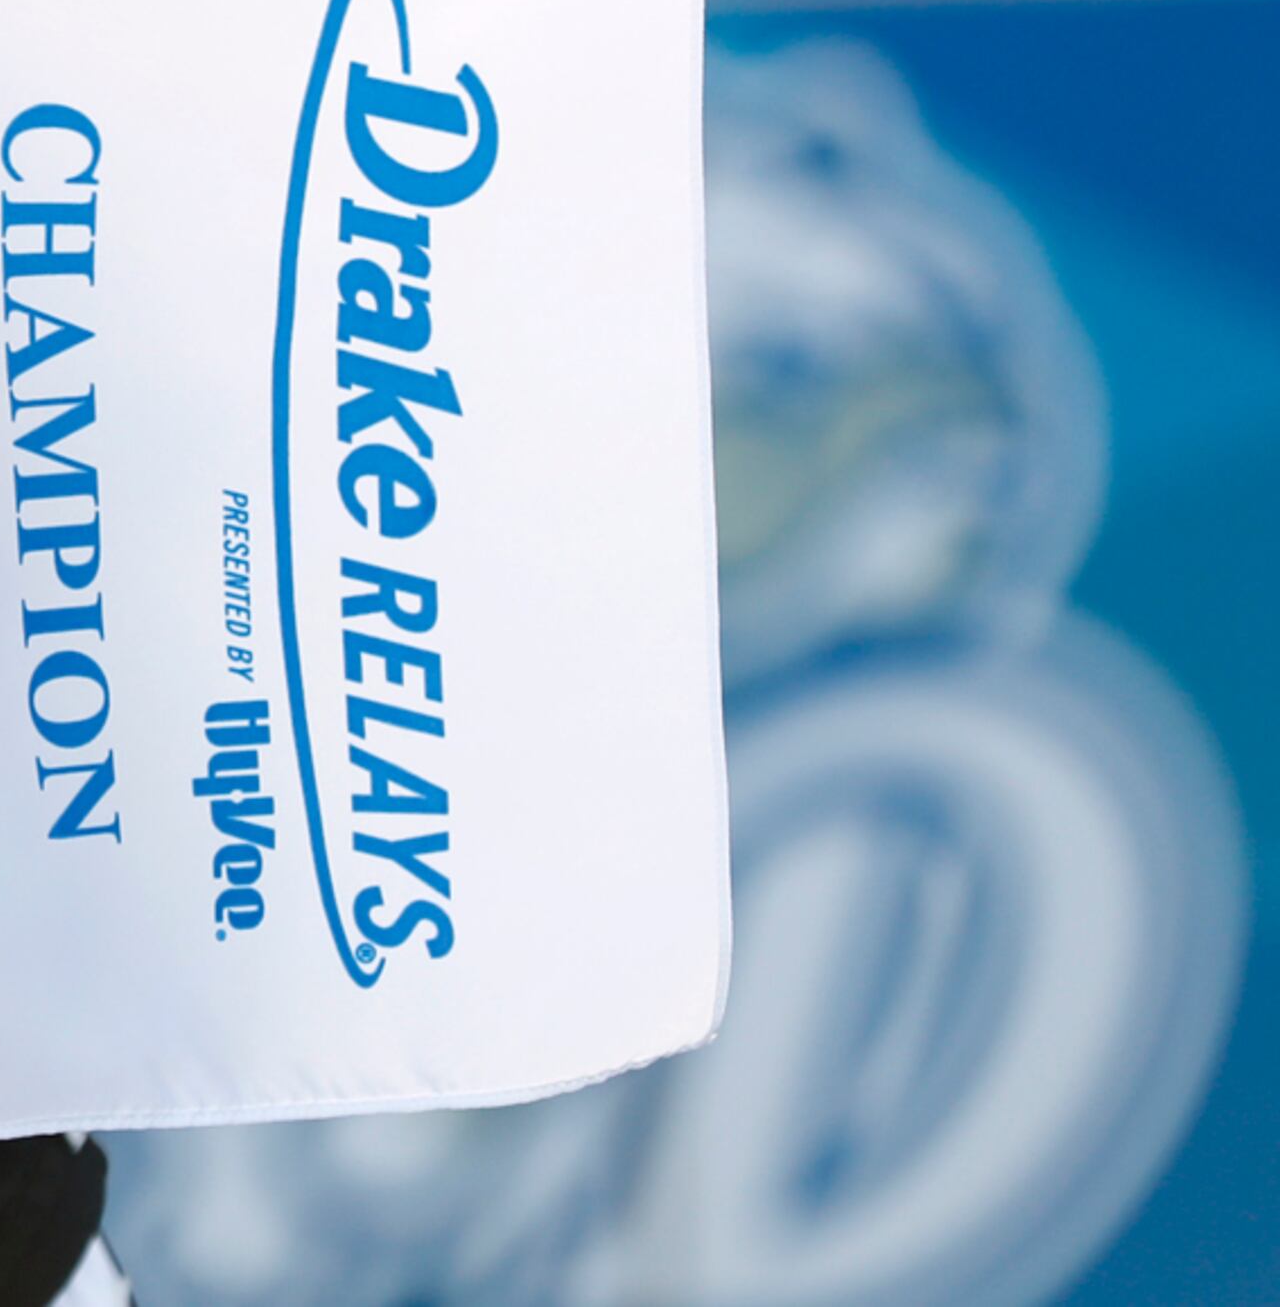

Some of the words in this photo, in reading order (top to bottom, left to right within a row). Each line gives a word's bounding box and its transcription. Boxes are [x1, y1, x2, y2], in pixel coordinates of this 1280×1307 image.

[335, 60, 500, 541] Drake
[0, 102, 123, 843] CHAMPION
[222, 489, 253, 638] PRESENTED
[226, 645, 254, 682] BY
